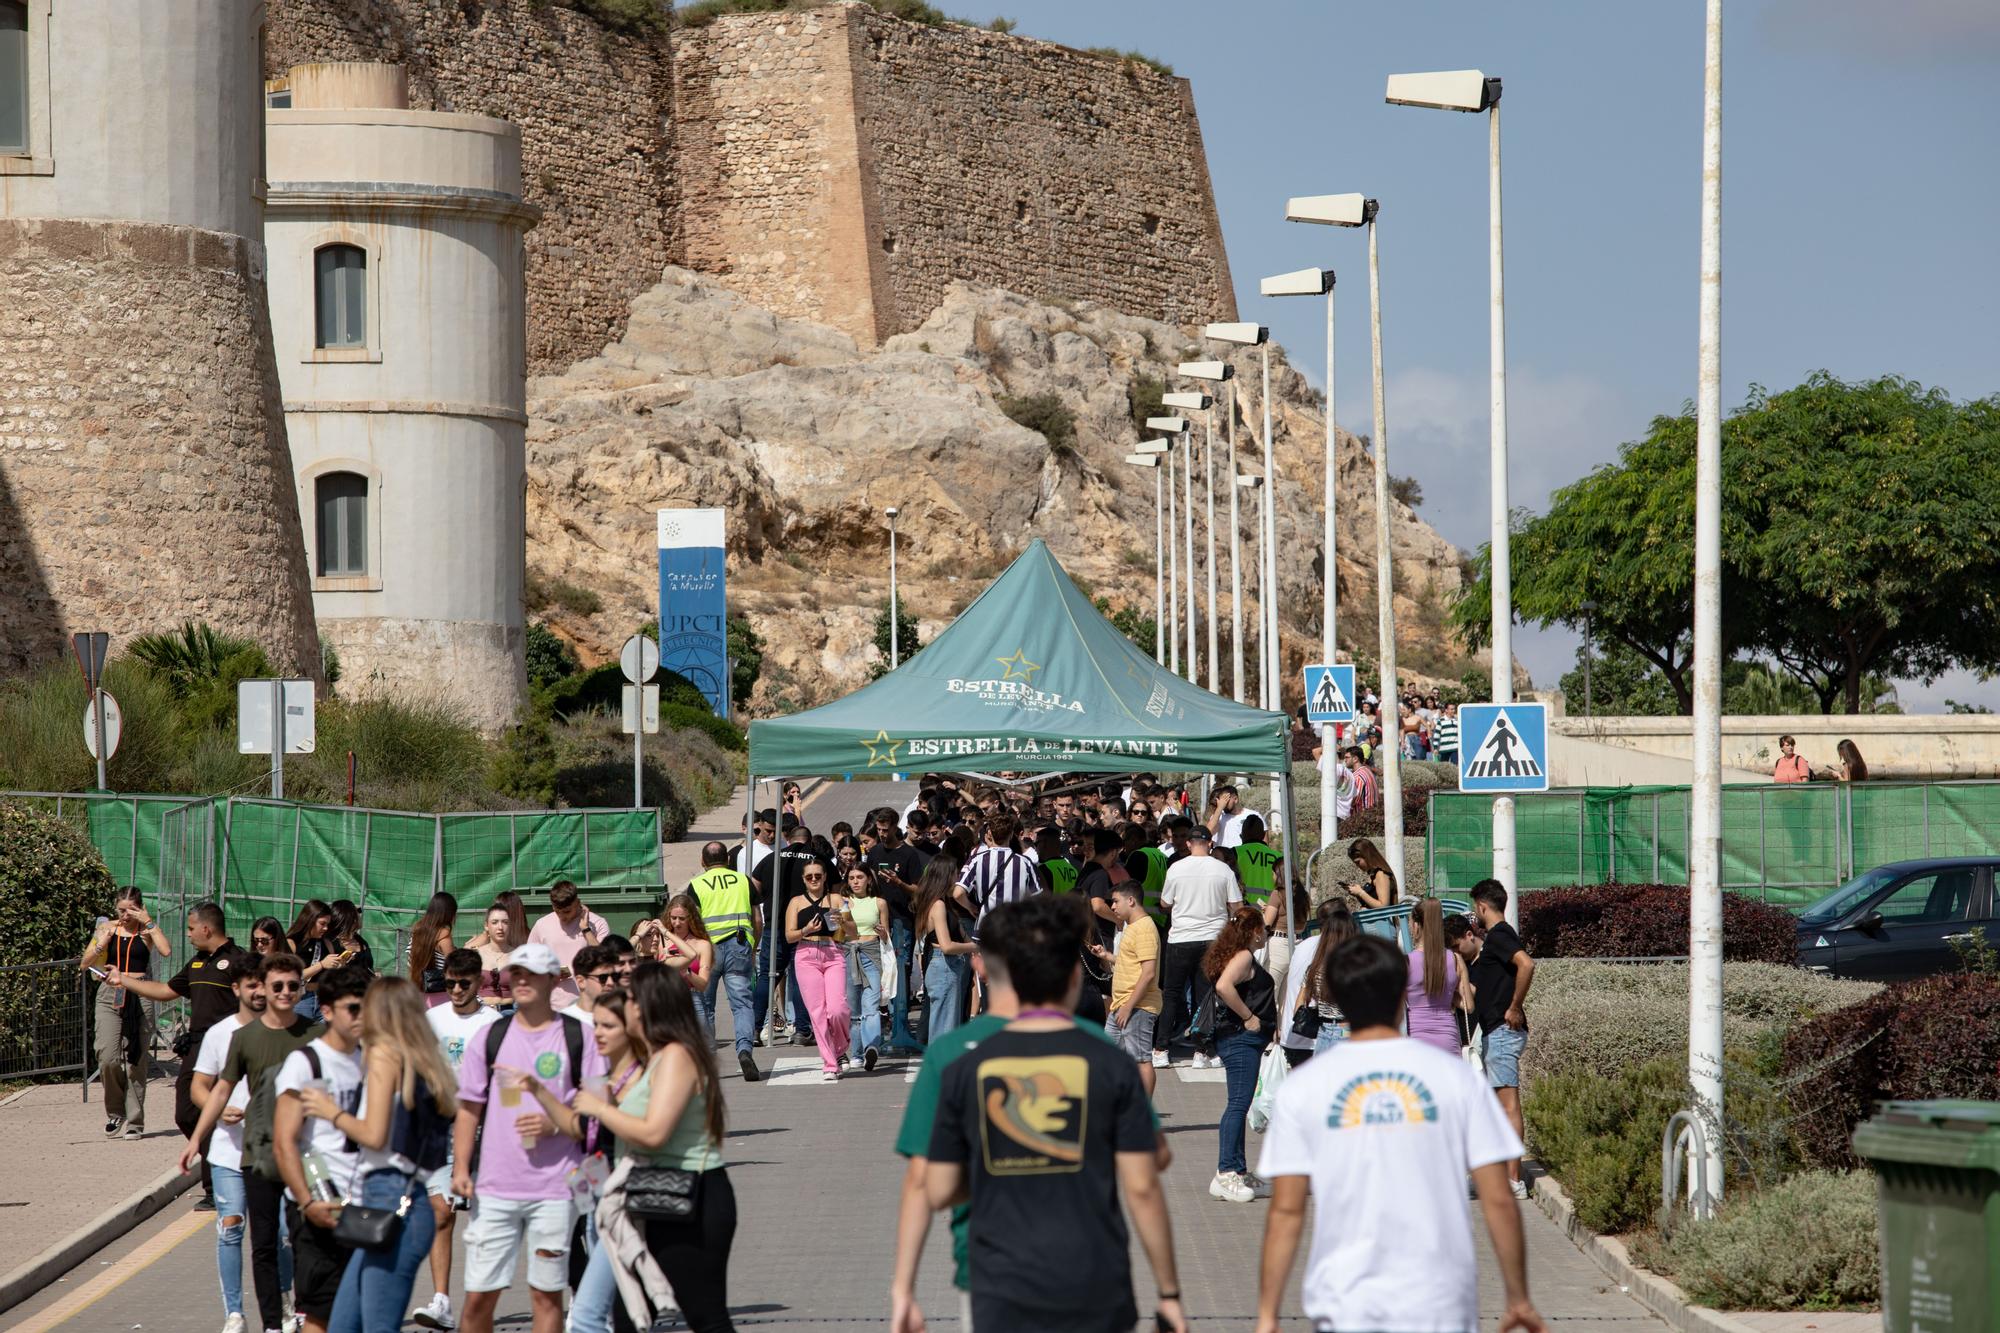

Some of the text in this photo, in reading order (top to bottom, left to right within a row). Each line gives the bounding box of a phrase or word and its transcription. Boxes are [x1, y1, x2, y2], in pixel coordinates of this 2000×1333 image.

[662, 614, 723, 632] UPCT
[946, 679, 1085, 713] ESTRELLA
[908, 737, 1178, 756] ESTRELLA DE LEVANTE
[1246, 850, 1277, 867] VIP
[702, 874, 738, 890] VIP
[1057, 866, 1077, 883] VIP
